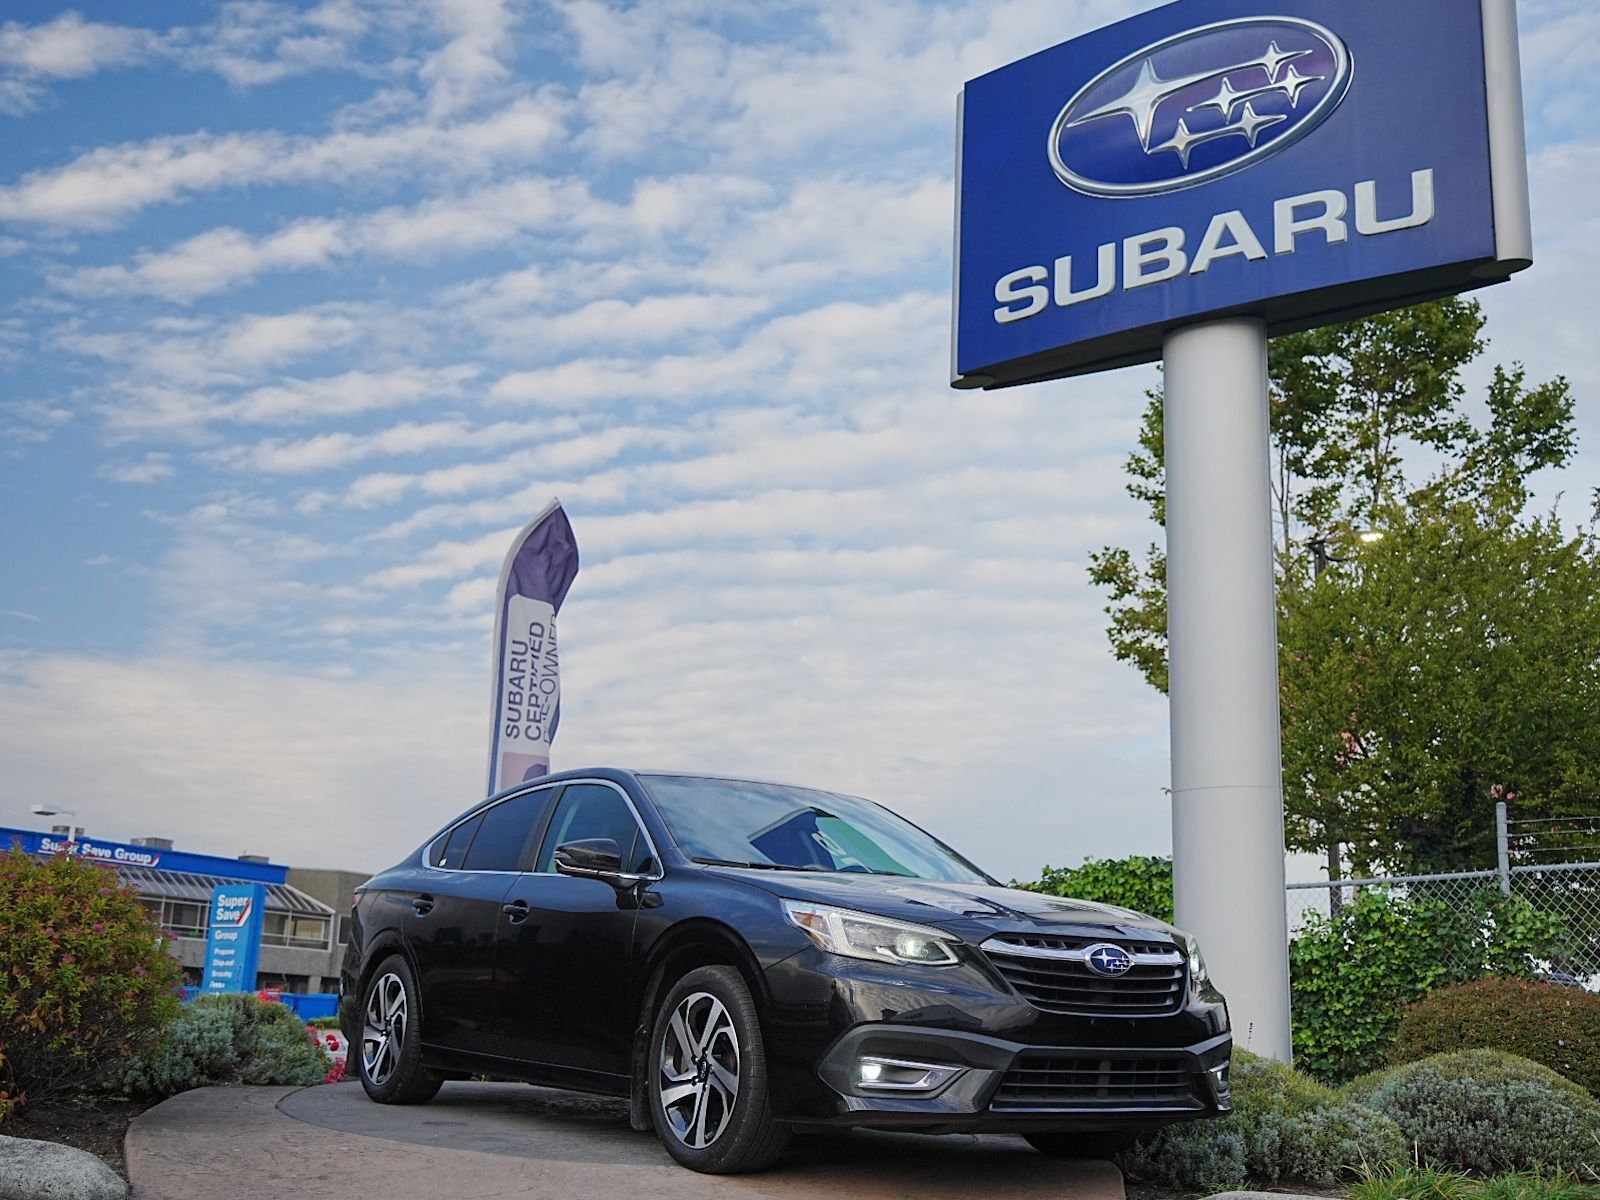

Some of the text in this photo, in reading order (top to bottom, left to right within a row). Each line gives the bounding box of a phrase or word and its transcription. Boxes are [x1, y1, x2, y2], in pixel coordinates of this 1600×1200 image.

[993, 167, 1435, 325] SUBARU
[505, 639, 529, 740] SUBARU
[82, 843, 111, 857] Save
[115, 848, 152, 864] Group
[217, 894, 248, 910] Super
[215, 907, 241, 921] Save
[214, 929, 238, 942] Group
